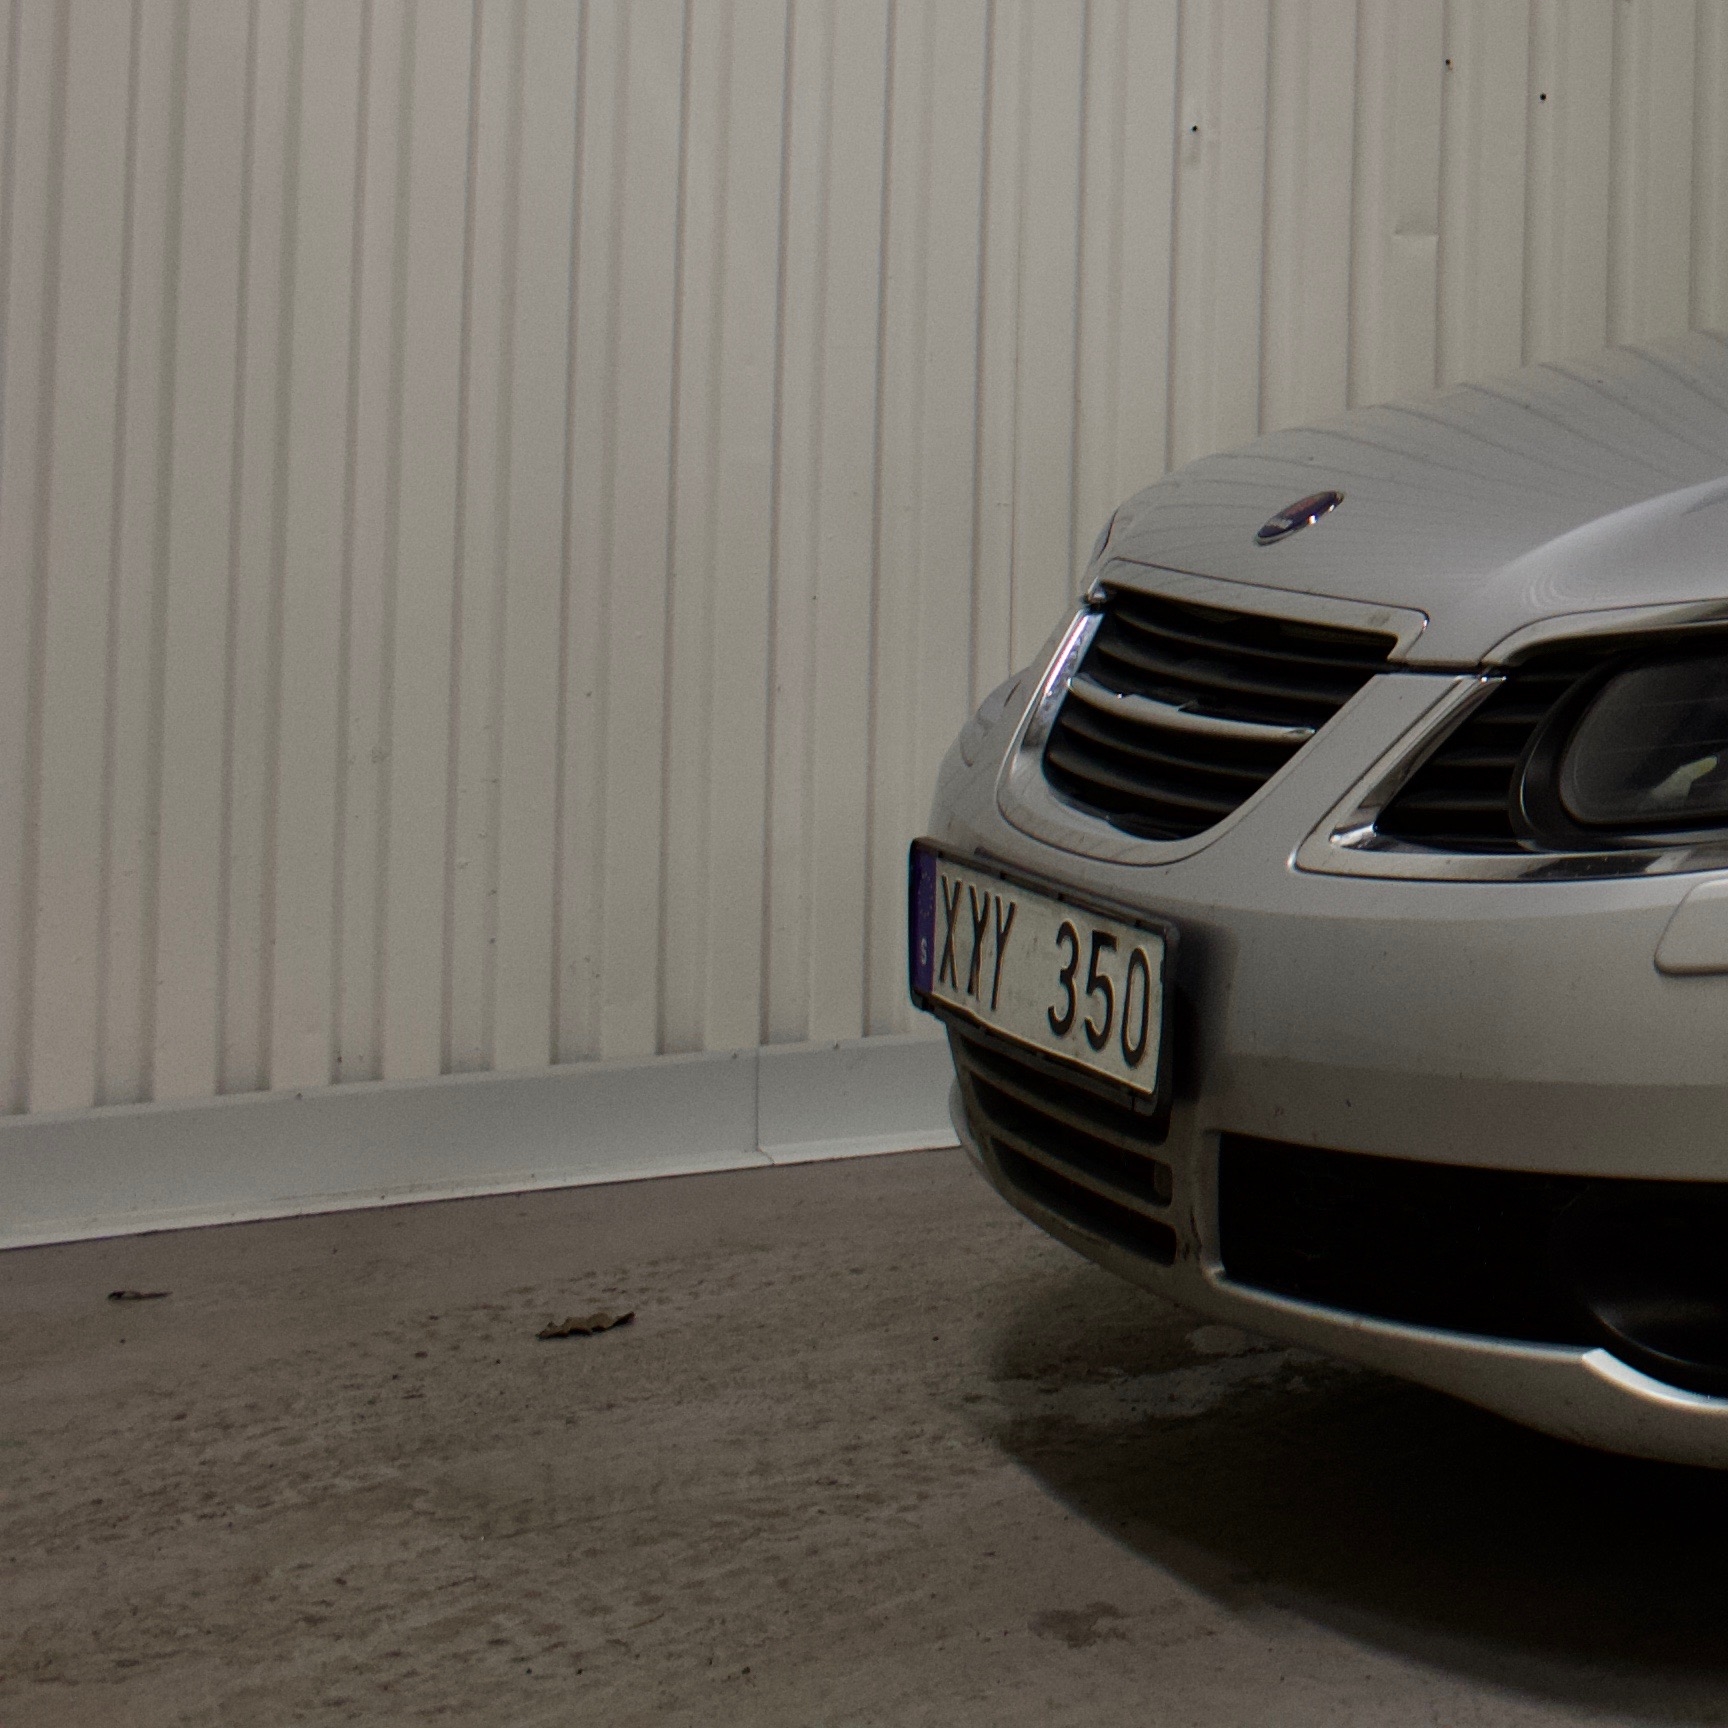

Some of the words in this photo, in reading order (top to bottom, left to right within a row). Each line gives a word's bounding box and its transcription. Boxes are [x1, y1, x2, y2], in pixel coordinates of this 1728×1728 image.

[918, 936, 928, 966] S
[938, 873, 1018, 1012] XYY
[1047, 918, 1151, 1071] 350
